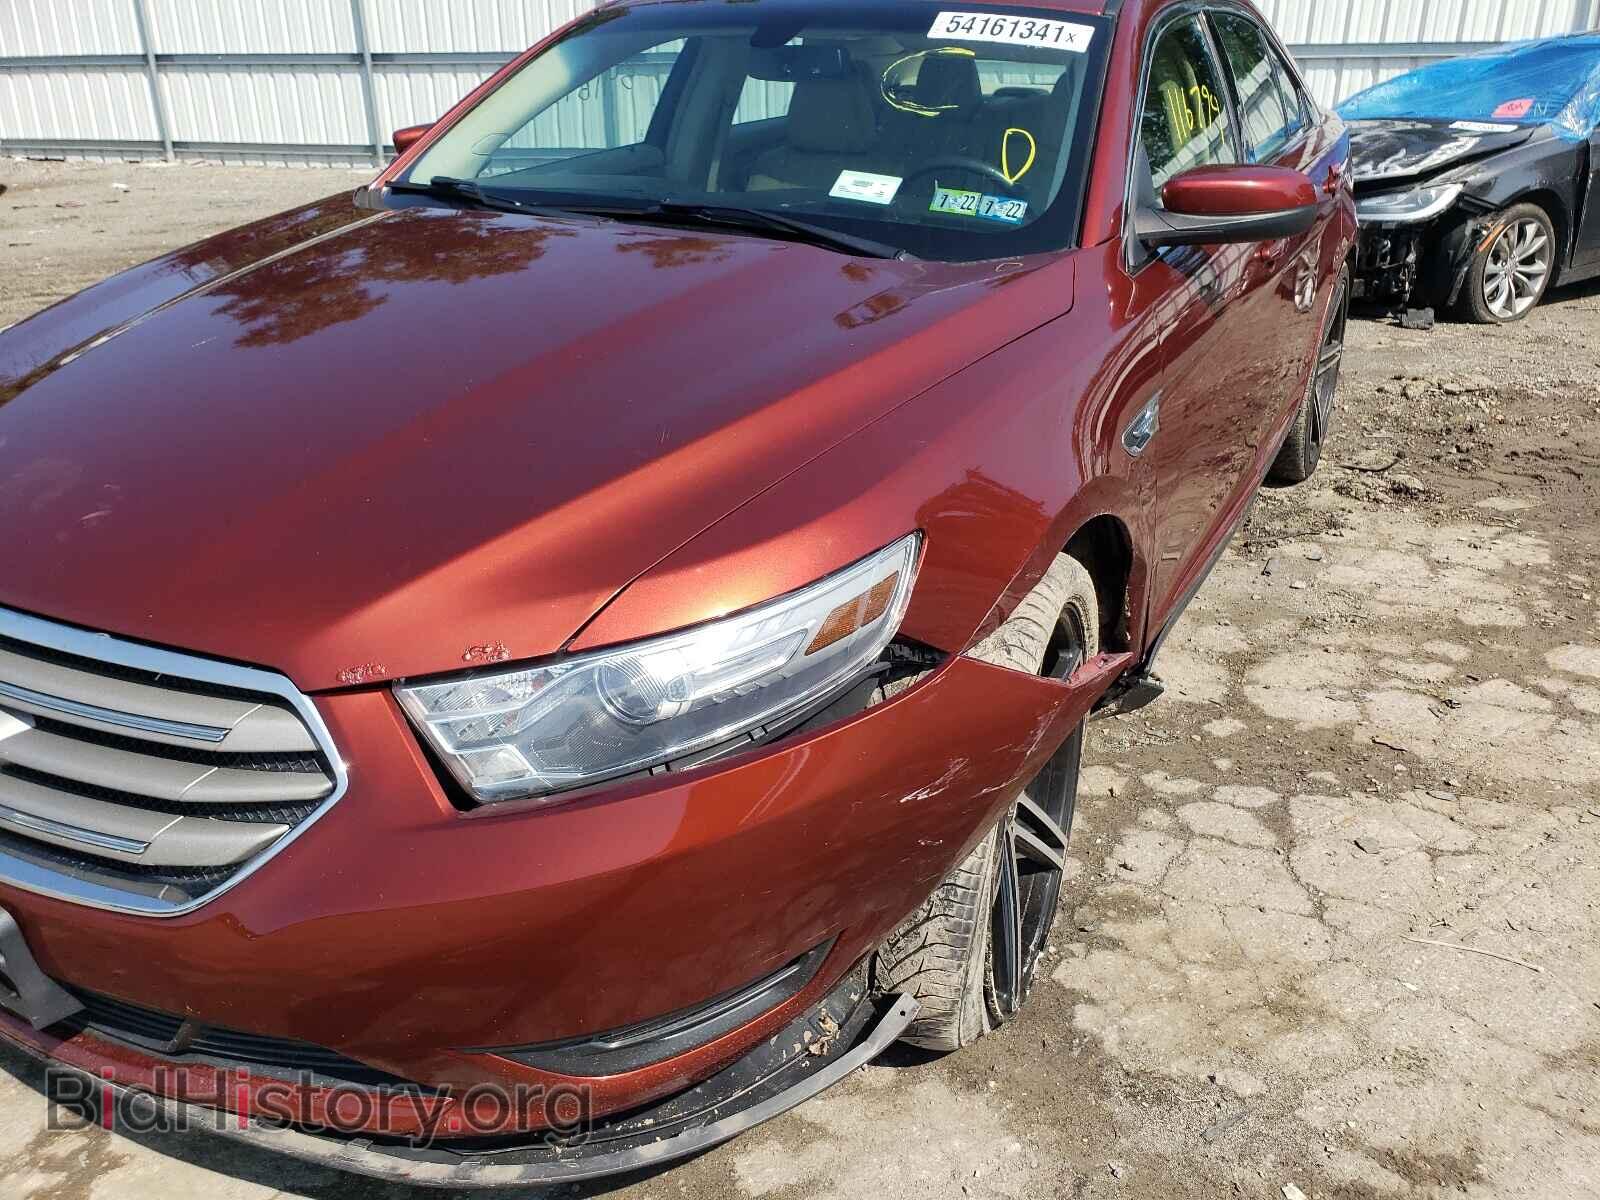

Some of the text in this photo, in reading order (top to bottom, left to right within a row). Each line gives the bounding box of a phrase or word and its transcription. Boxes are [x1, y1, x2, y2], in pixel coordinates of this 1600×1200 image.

[940, 195, 975, 210] 7 22
[1006, 202, 1020, 217] 22
